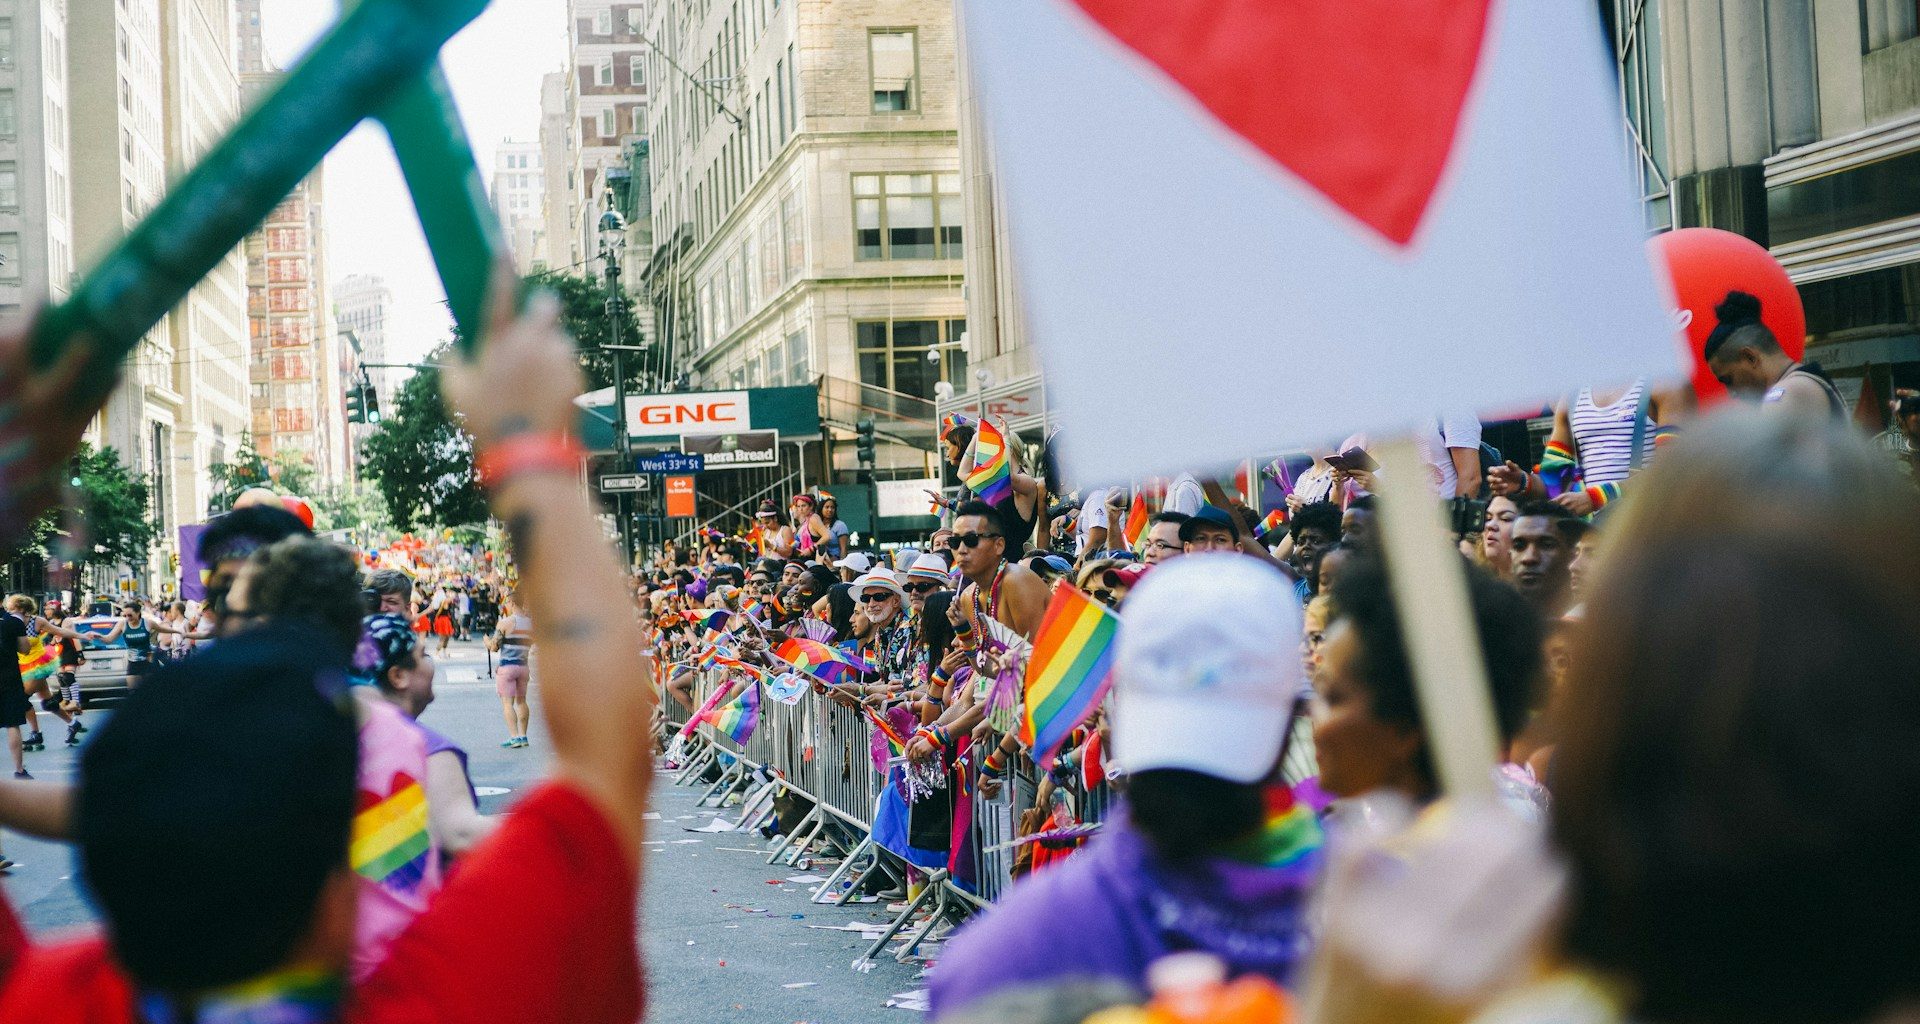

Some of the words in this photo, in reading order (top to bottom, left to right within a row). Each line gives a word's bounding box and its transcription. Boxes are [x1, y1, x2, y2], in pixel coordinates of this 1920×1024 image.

[639, 402, 736, 424] GNC
[734, 448, 774, 461] Bread
[641, 460, 666, 471] West
[668, 458, 687, 470] 33rd
[688, 458, 699, 469] St
